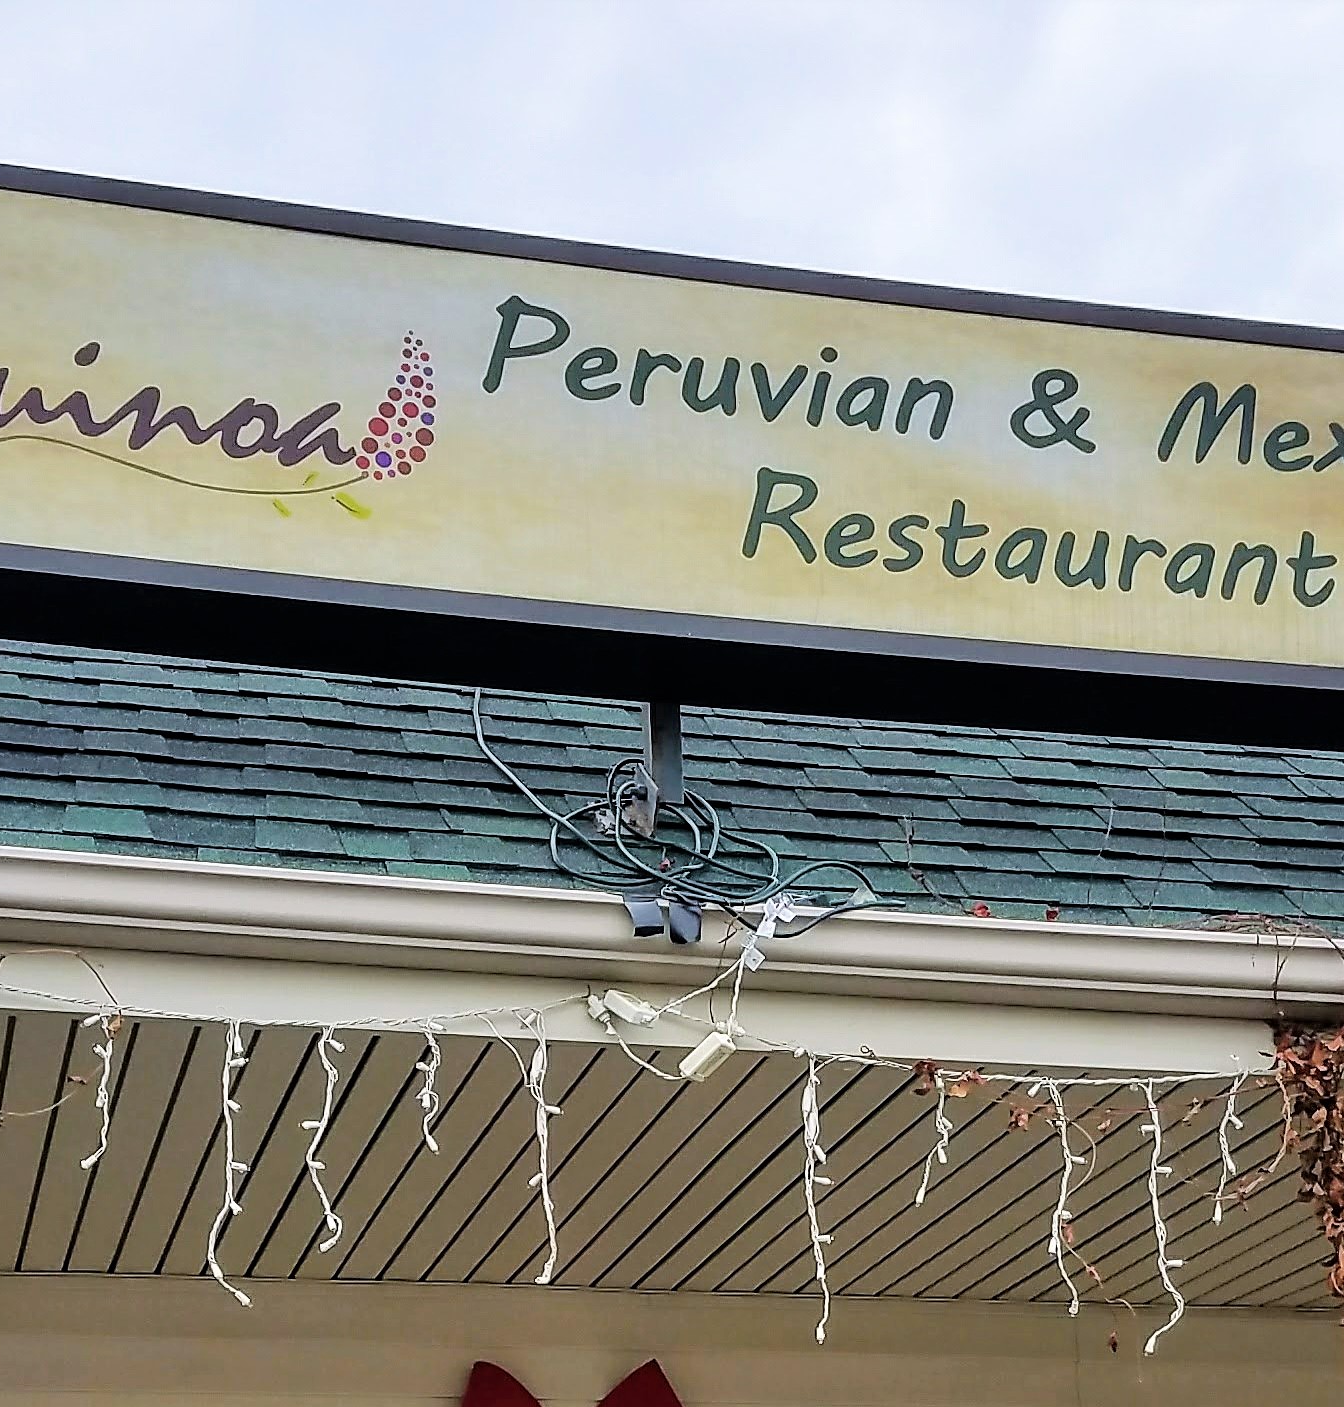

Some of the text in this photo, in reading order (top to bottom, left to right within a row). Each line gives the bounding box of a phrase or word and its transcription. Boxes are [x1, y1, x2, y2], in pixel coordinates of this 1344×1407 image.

[481, 294, 954, 441] Peruvian
[1008, 367, 1098, 455] &
[740, 466, 1339, 607] Restaurant
